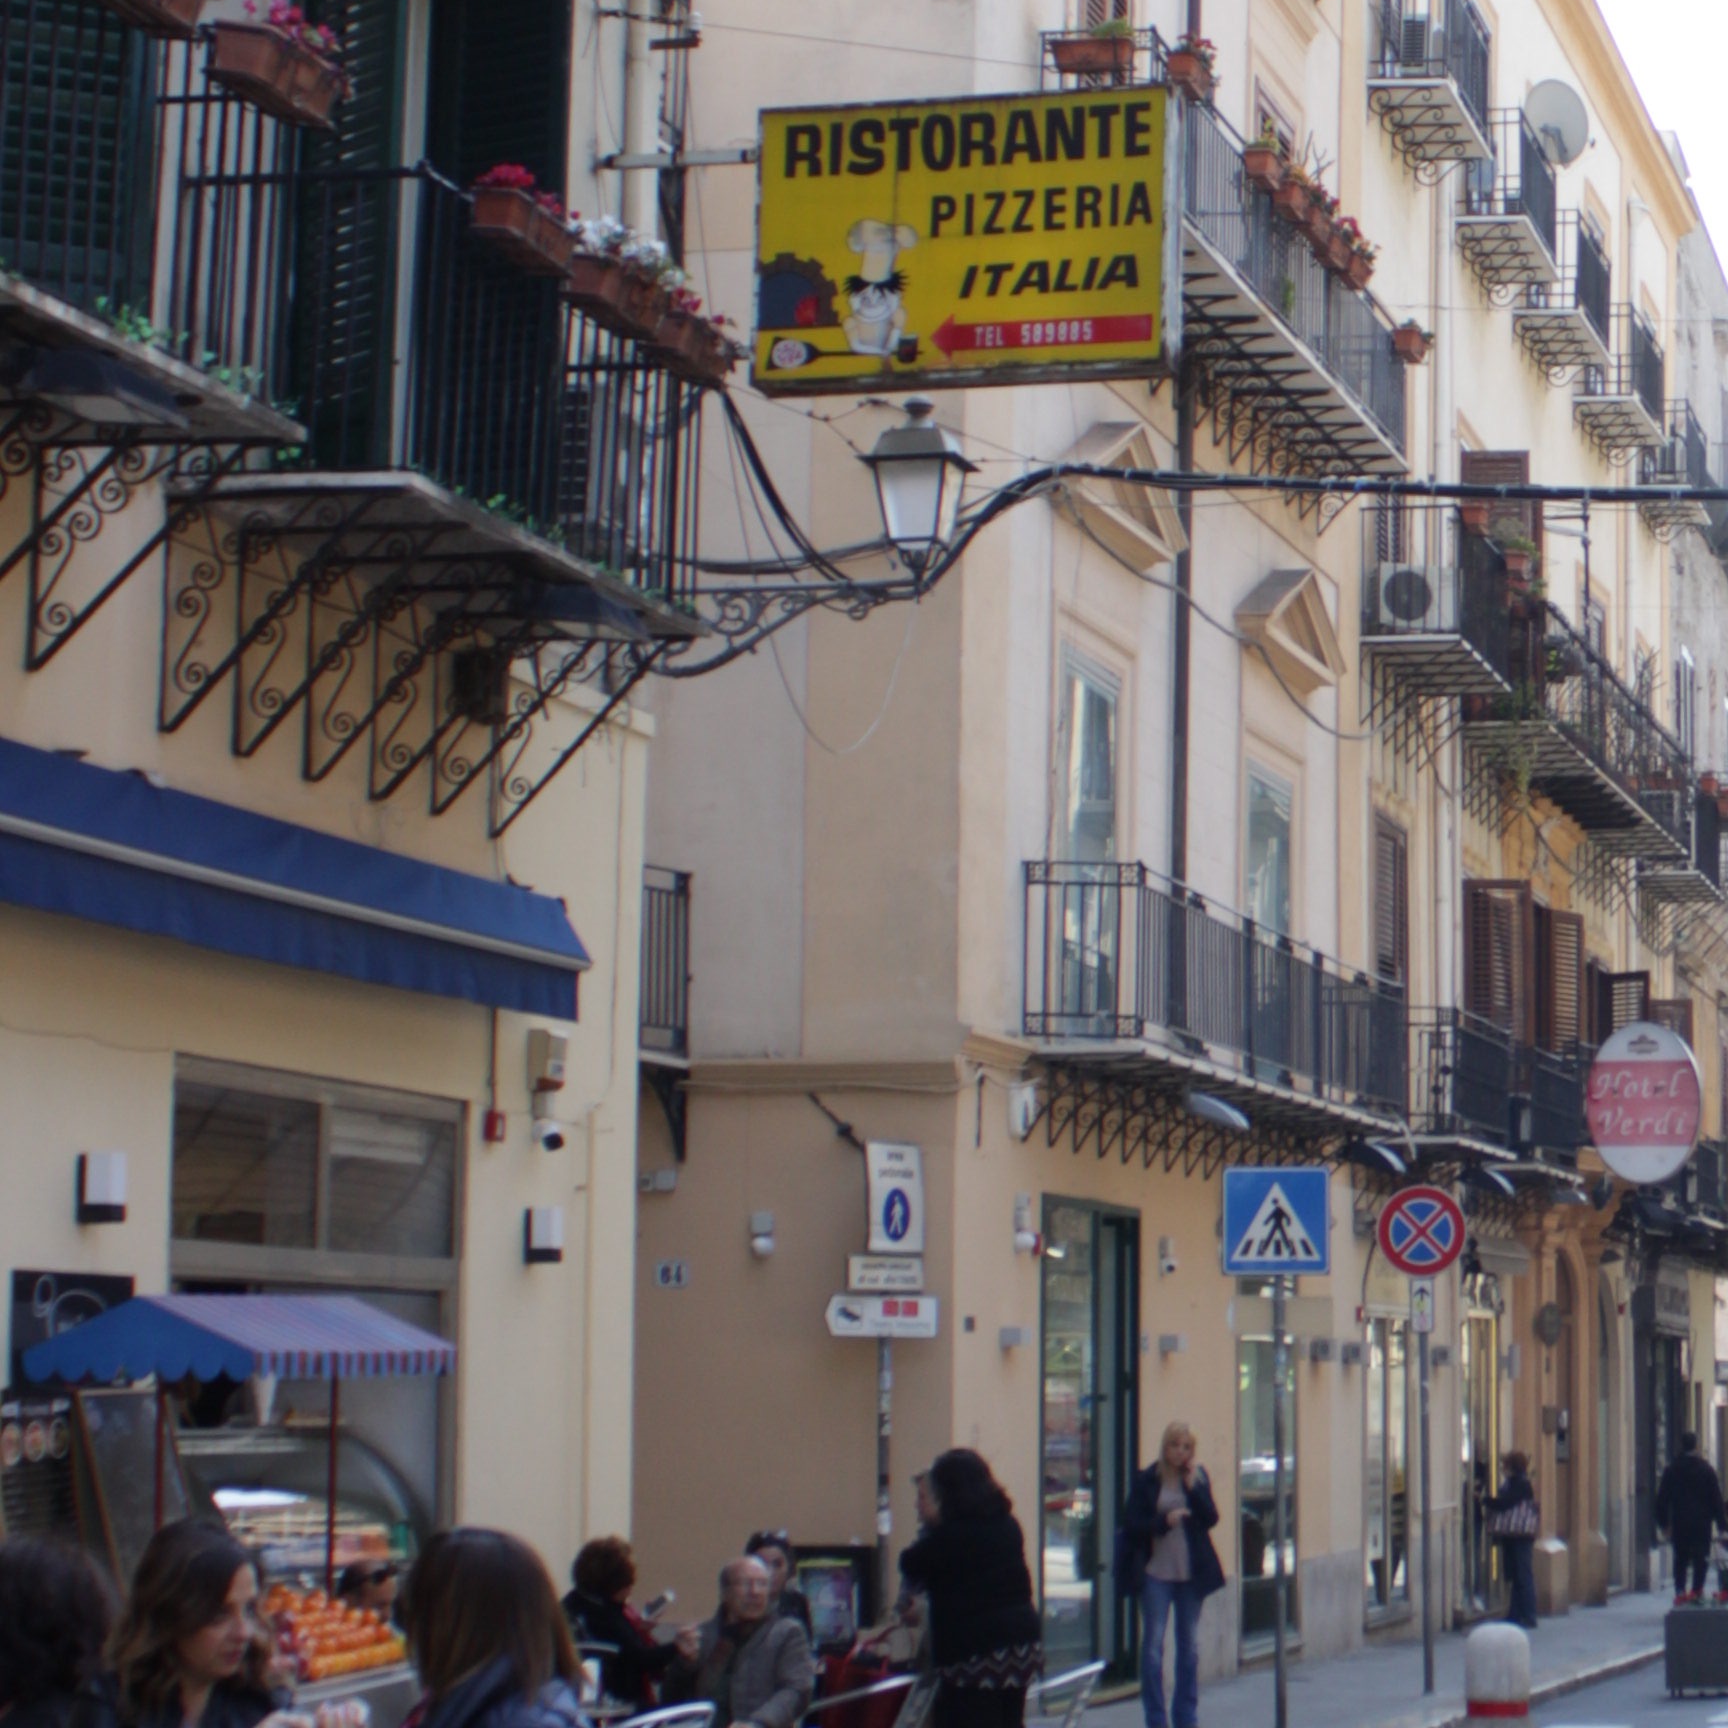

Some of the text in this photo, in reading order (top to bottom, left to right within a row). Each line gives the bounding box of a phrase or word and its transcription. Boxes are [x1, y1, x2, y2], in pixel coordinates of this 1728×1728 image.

[784, 102, 1151, 178] RISTORANTE
[930, 182, 1153, 238] PIZZERIA
[958, 254, 1139, 298] ITALIA
[975, 325, 1003, 348] TEL
[1598, 1104, 1688, 1136] Verdi
